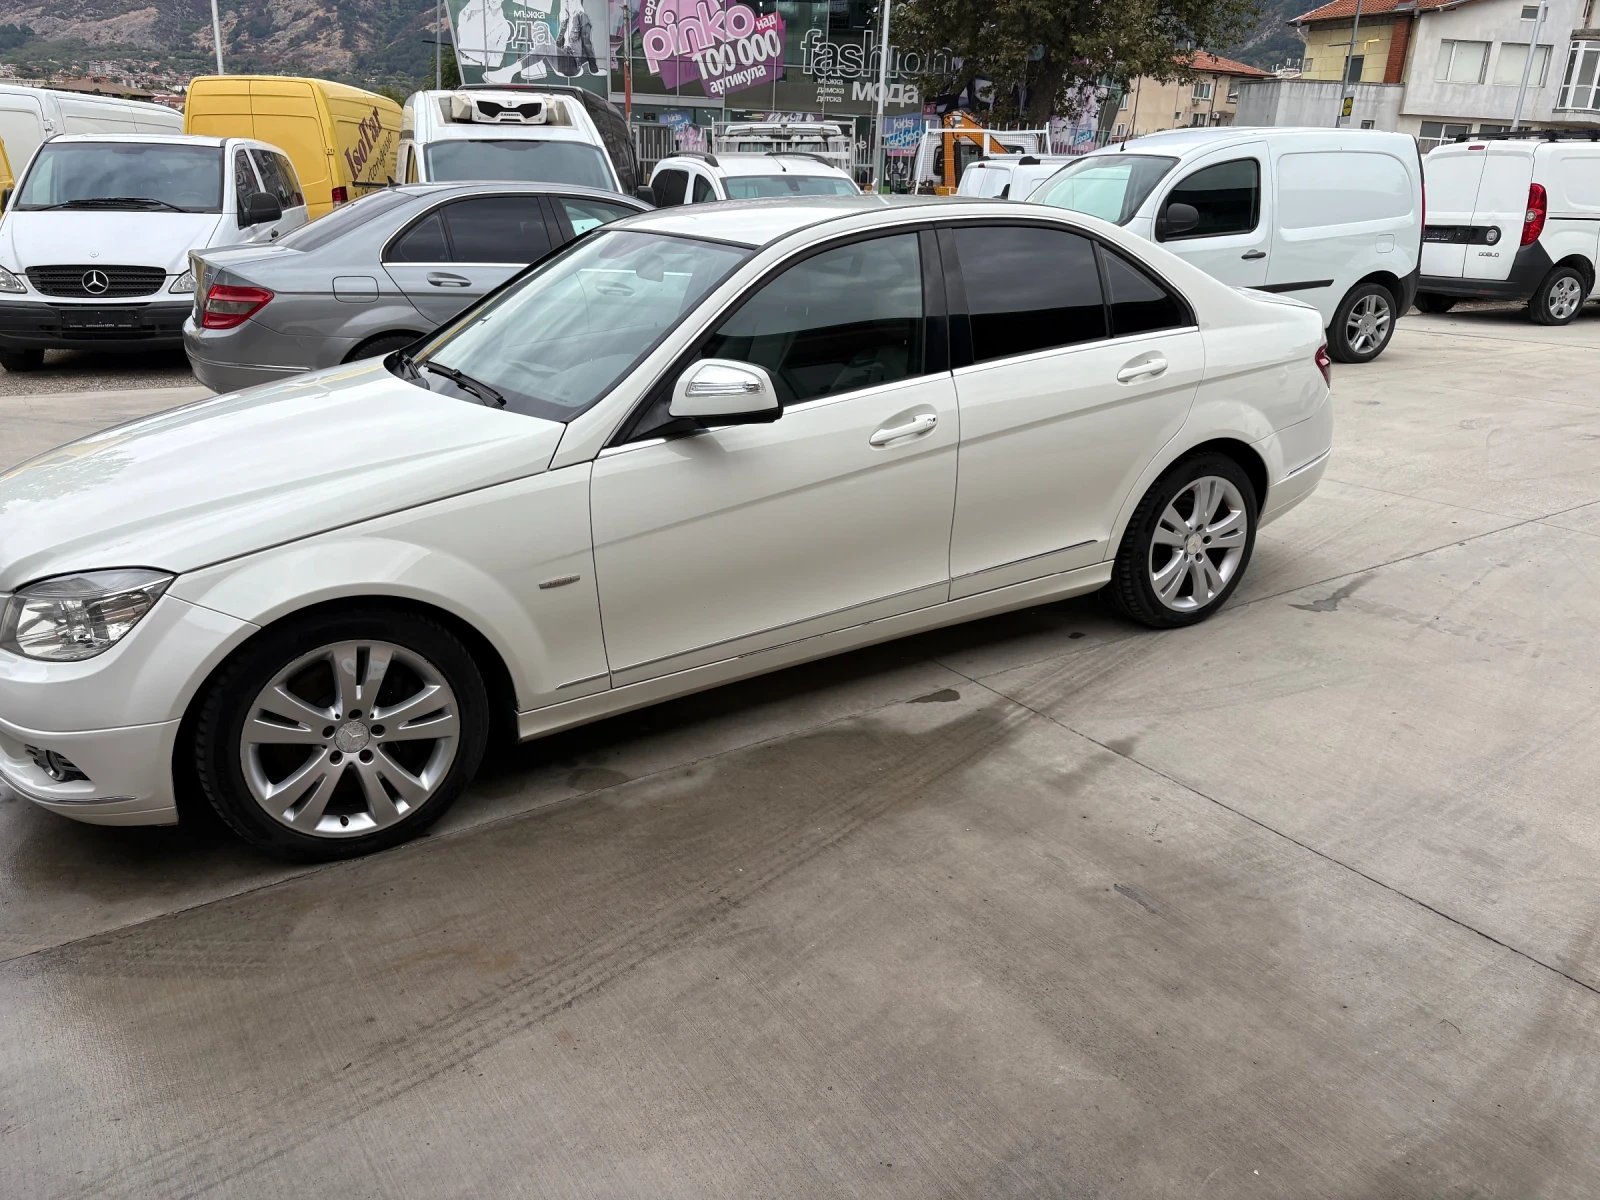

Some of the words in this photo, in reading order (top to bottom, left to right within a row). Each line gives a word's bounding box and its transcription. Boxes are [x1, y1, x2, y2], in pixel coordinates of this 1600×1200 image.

[513, 10, 546, 19] мъжка
[756, 14, 777, 31] над
[642, 1, 756, 74] pinko
[692, 43, 737, 80] 100
[736, 28, 781, 66] 000
[800, 28, 956, 79] fashion
[709, 64, 767, 95] артикула
[816, 87, 845, 95] дамска
[893, 117, 914, 129] kids
